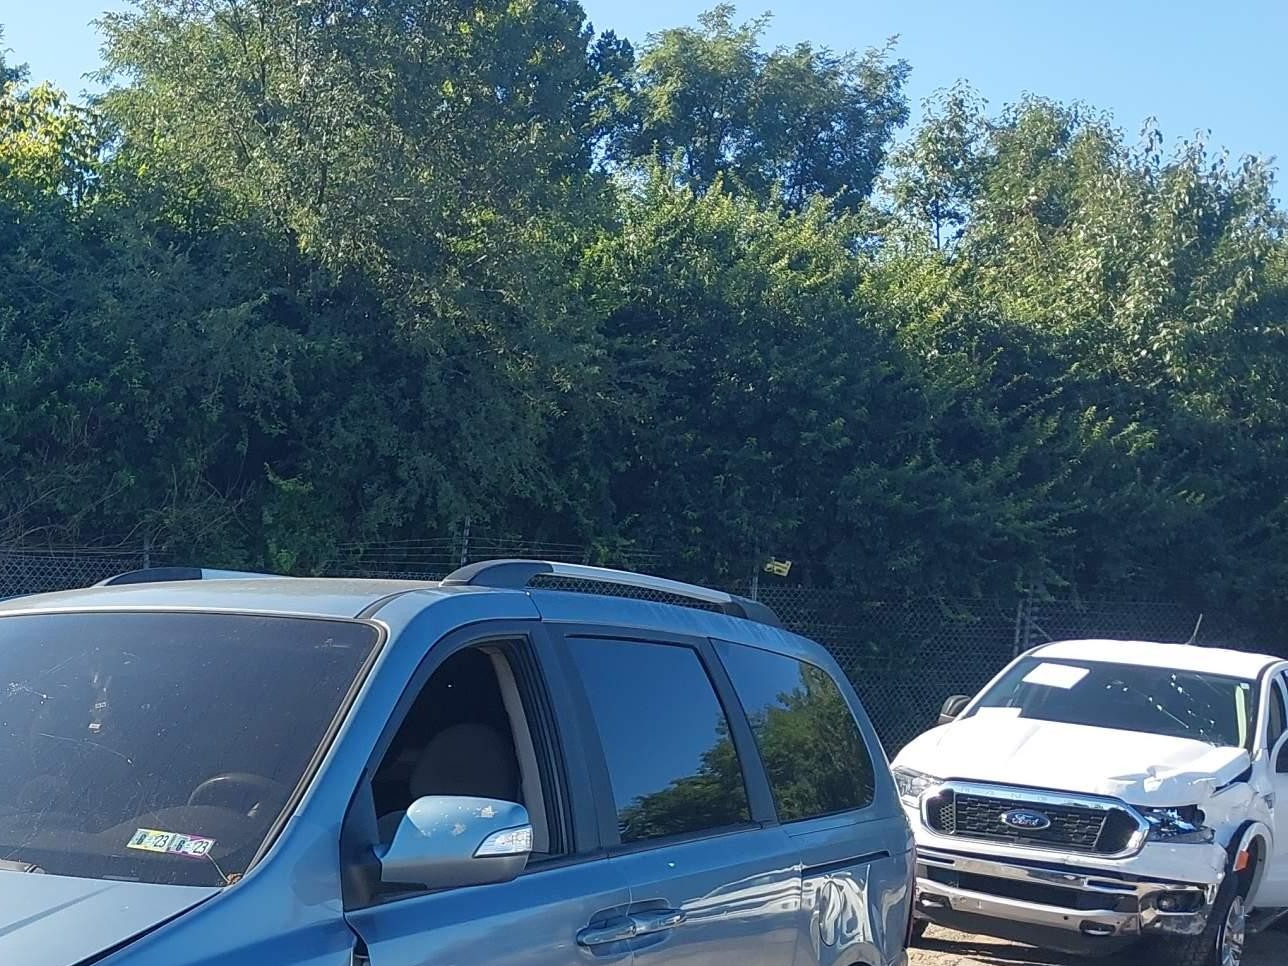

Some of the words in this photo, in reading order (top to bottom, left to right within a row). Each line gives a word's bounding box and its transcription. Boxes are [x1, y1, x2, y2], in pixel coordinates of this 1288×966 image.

[1011, 813, 1040, 826] Ford
[153, 835, 170, 848] 23
[192, 840, 210, 854] 23
